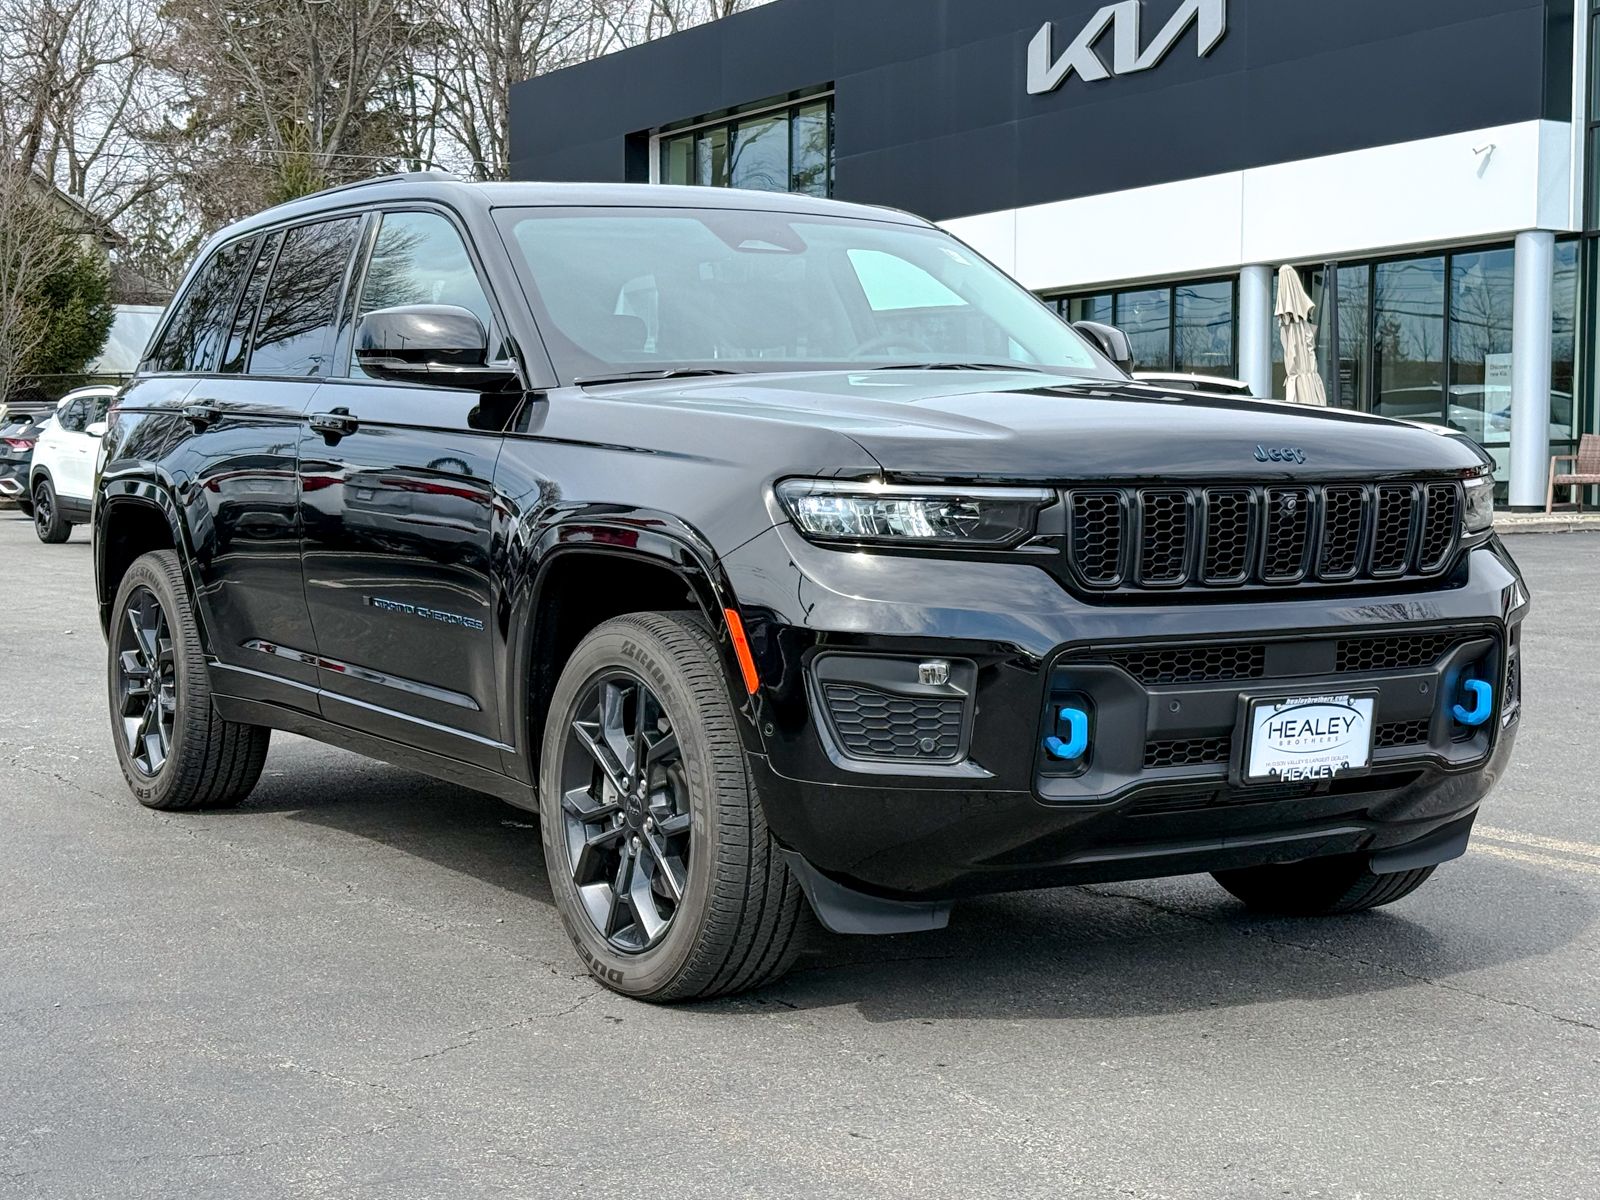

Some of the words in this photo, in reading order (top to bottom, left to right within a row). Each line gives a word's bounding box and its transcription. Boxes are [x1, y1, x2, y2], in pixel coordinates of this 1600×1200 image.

[1027, 0, 1225, 94] KIA
[1253, 444, 1306, 464] Jeep
[416, 606, 484, 631] CHEROKEE
[1268, 716, 1356, 739] HEALEY
[1279, 736, 1338, 746] BROTHERS
[1280, 765, 1338, 782] HEALEY
